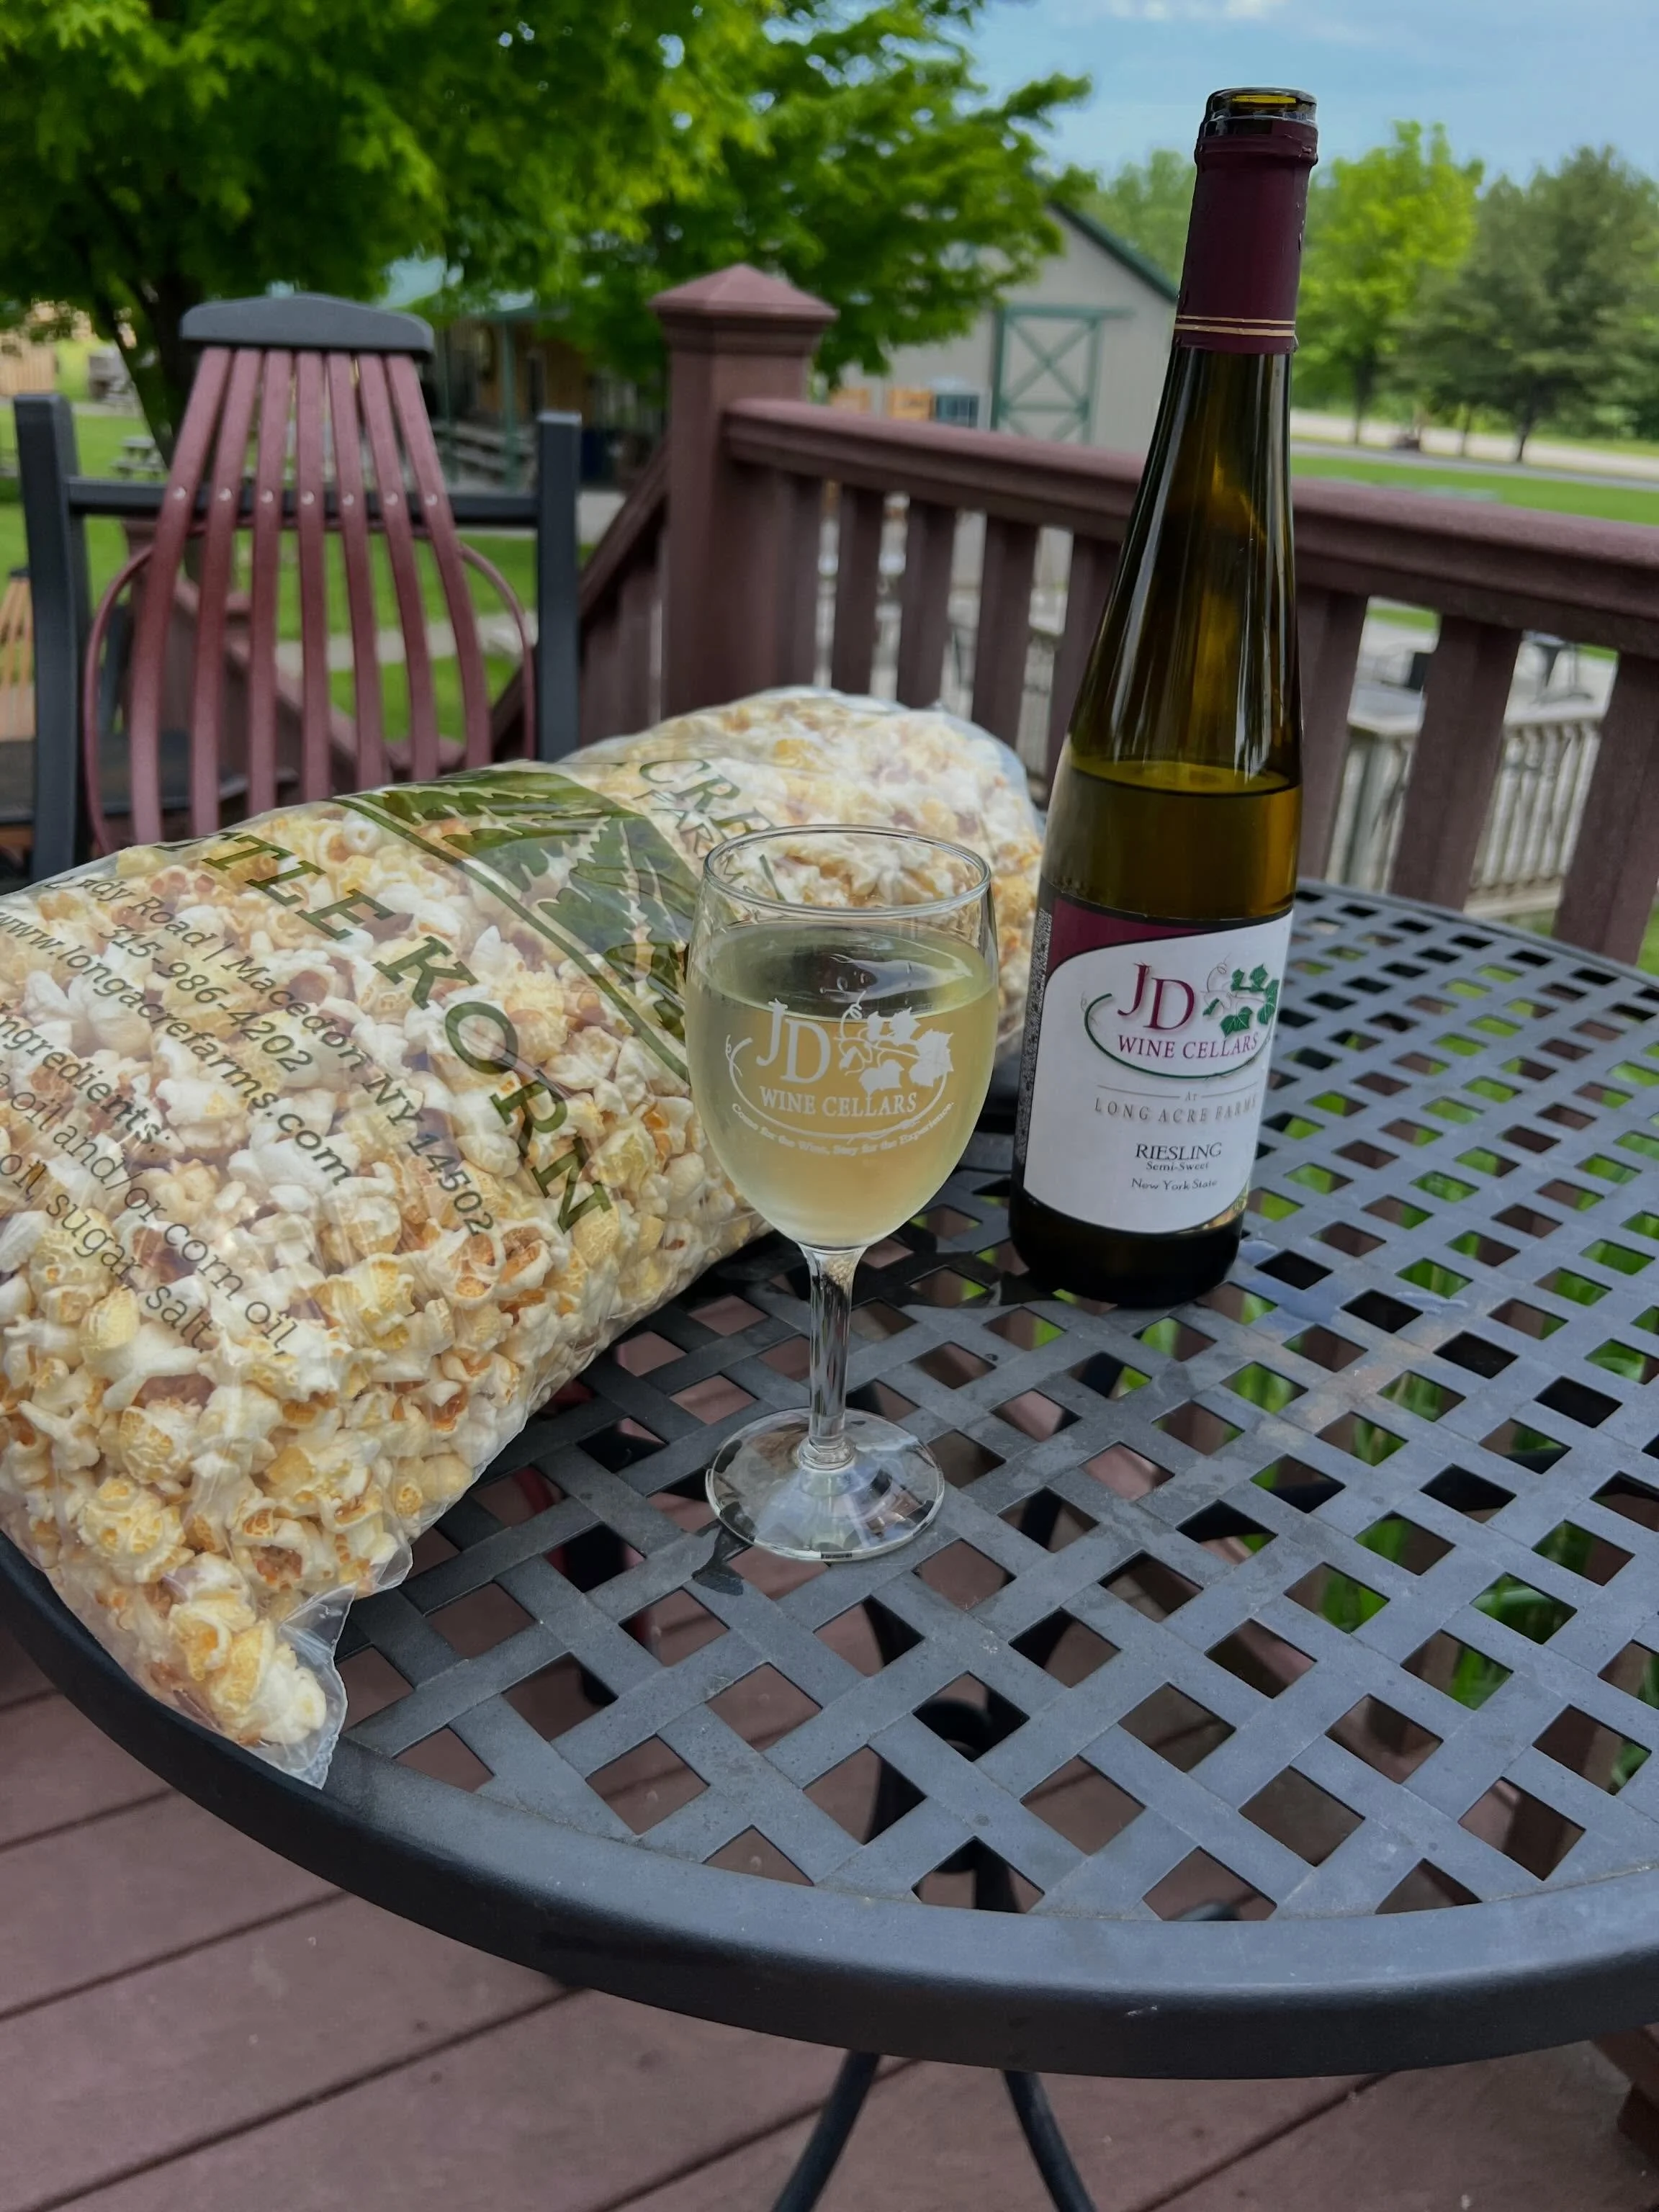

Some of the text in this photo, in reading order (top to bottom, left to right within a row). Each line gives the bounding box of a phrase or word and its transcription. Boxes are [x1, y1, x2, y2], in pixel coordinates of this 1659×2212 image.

[98, 924, 313, 1074] 315-986-4202
[1118, 963, 1195, 1030] JD
[128, 896, 222, 948] Road
[220, 956, 373, 1073] Macedon
[362, 1073, 426, 1126] NY
[407, 1133, 494, 1237] 14502
[756, 998, 831, 1084] JD
[1118, 1032, 1259, 1059] WINE CELLARS
[0, 1014, 171, 1153] ngredients:
[372, 935, 612, 1234] KORN
[759, 1086, 917, 1118] WINE CELLARS
[1095, 1094, 1256, 1124] LONG ACRE FARMS
[1131, 1177, 1218, 1191] New York State
[1135, 1141, 1223, 1161] RIESLING
[1146, 1161, 1210, 1172] Semi-Sweet
[0, 1154, 213, 1354] oil, sugar, salt.
[11, 1092, 298, 1357] oil and/or corn oil,
